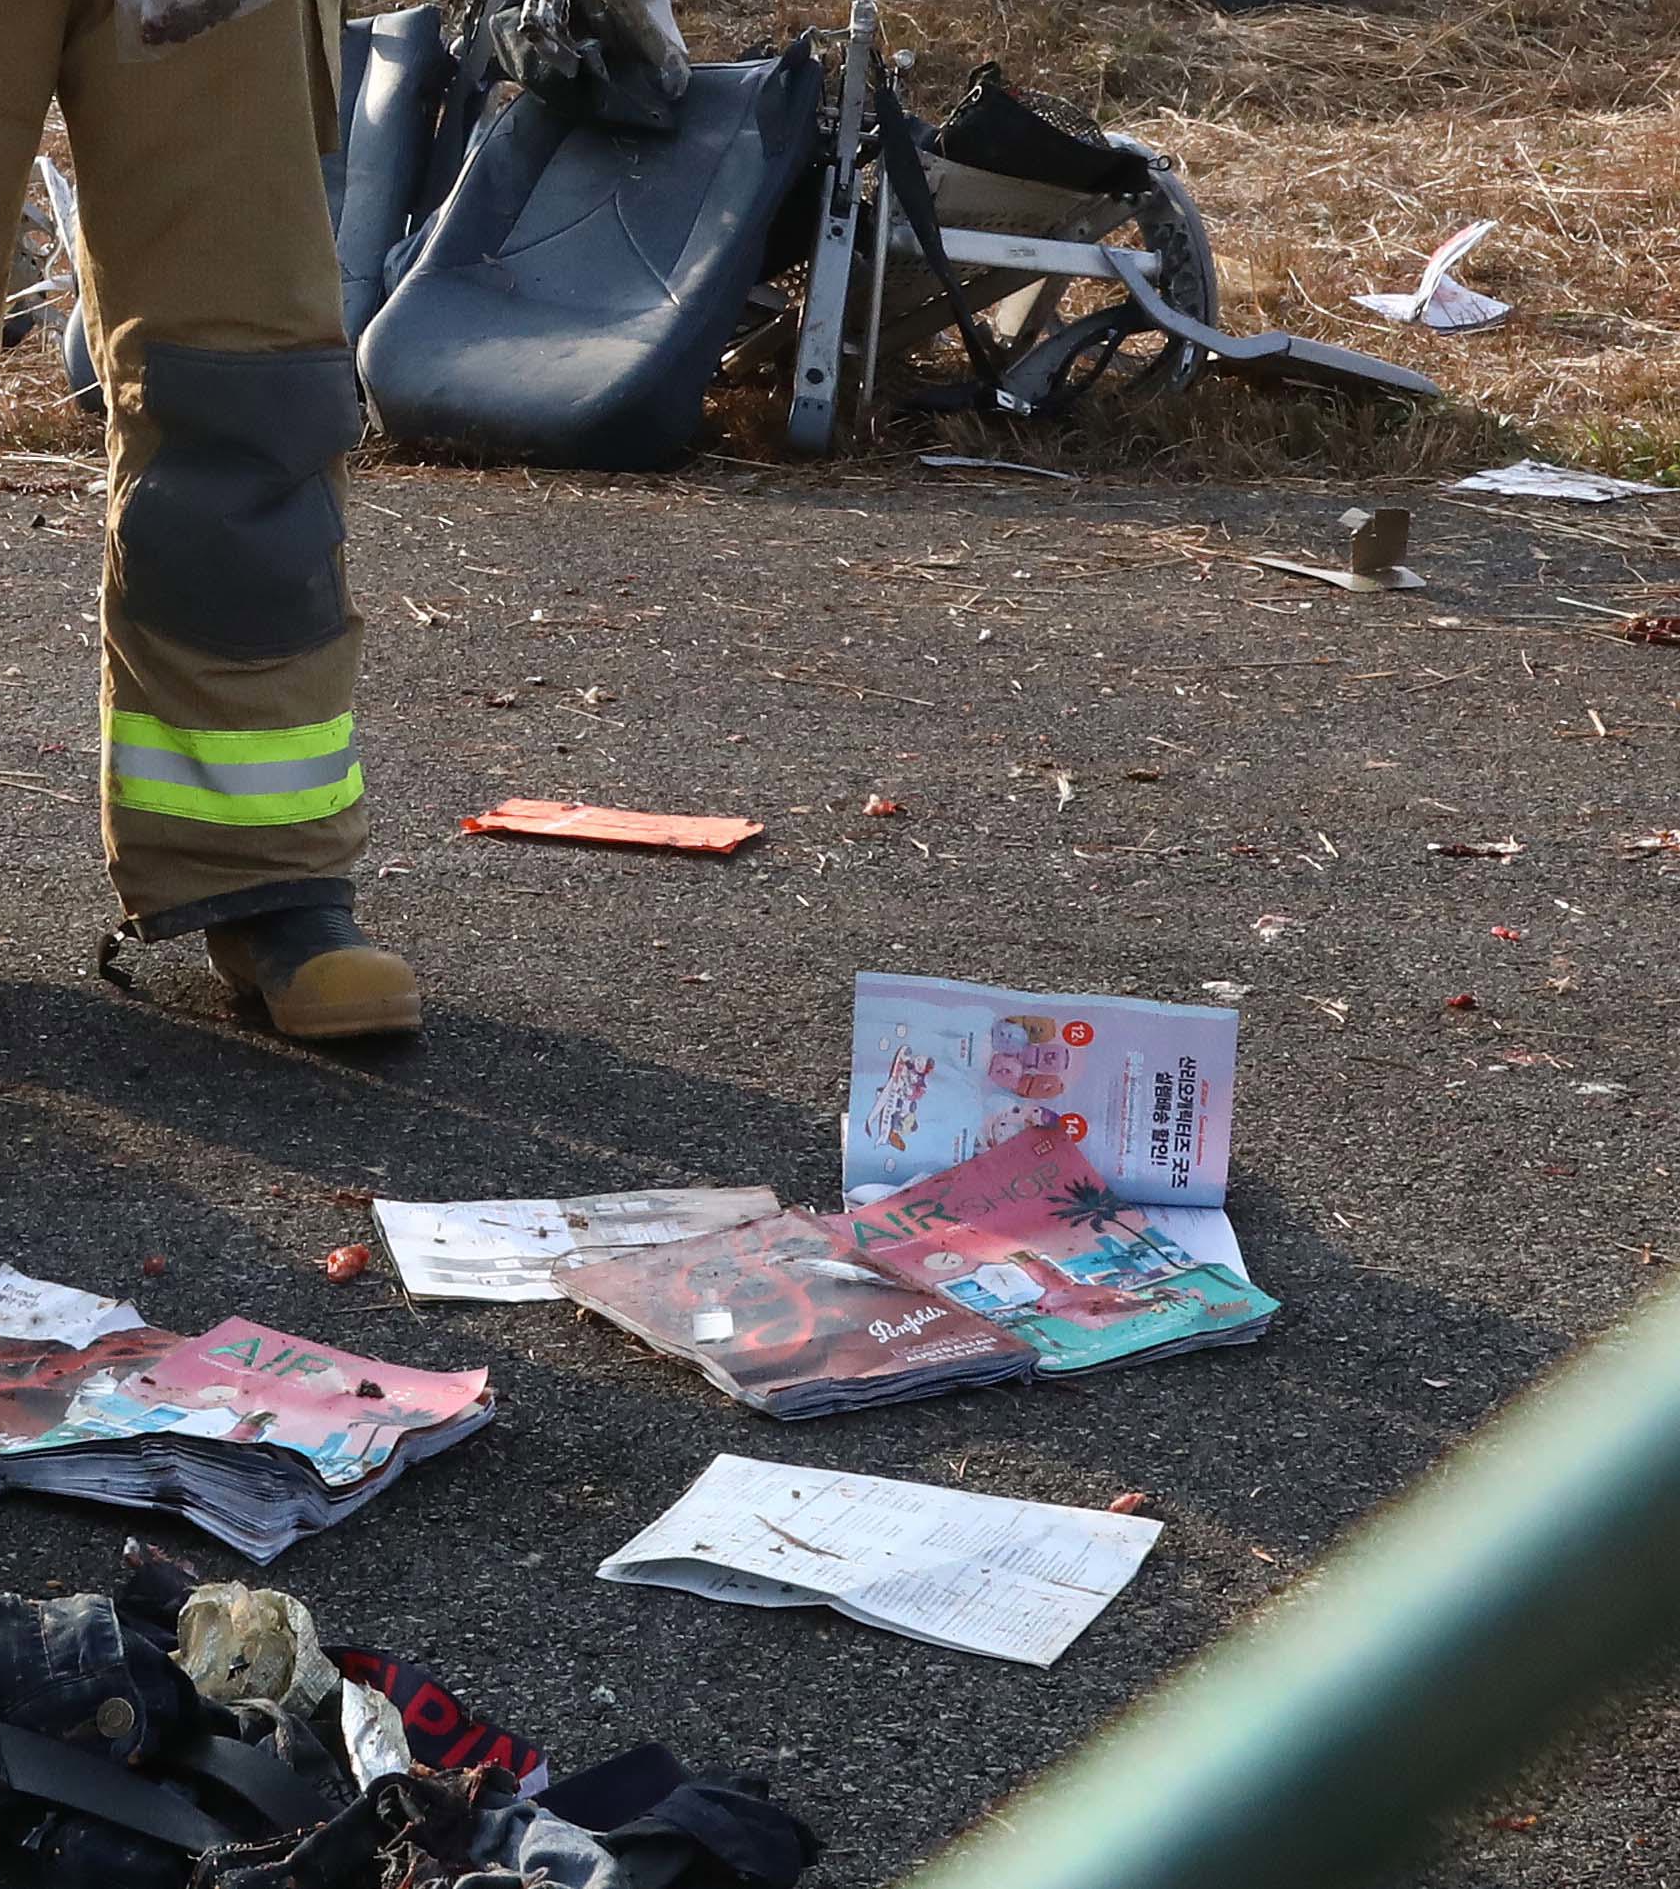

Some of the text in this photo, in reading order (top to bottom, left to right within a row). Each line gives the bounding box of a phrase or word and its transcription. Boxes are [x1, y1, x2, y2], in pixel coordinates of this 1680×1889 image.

[1150, 1129, 1169, 1167] 할인!
[1171, 1056, 1197, 1189] 산리오캐릭터즈 굿즈
[851, 1198, 961, 1249] AIR
[959, 1162, 1062, 1217] SHOP
[868, 1305, 949, 1344] Penfolds
